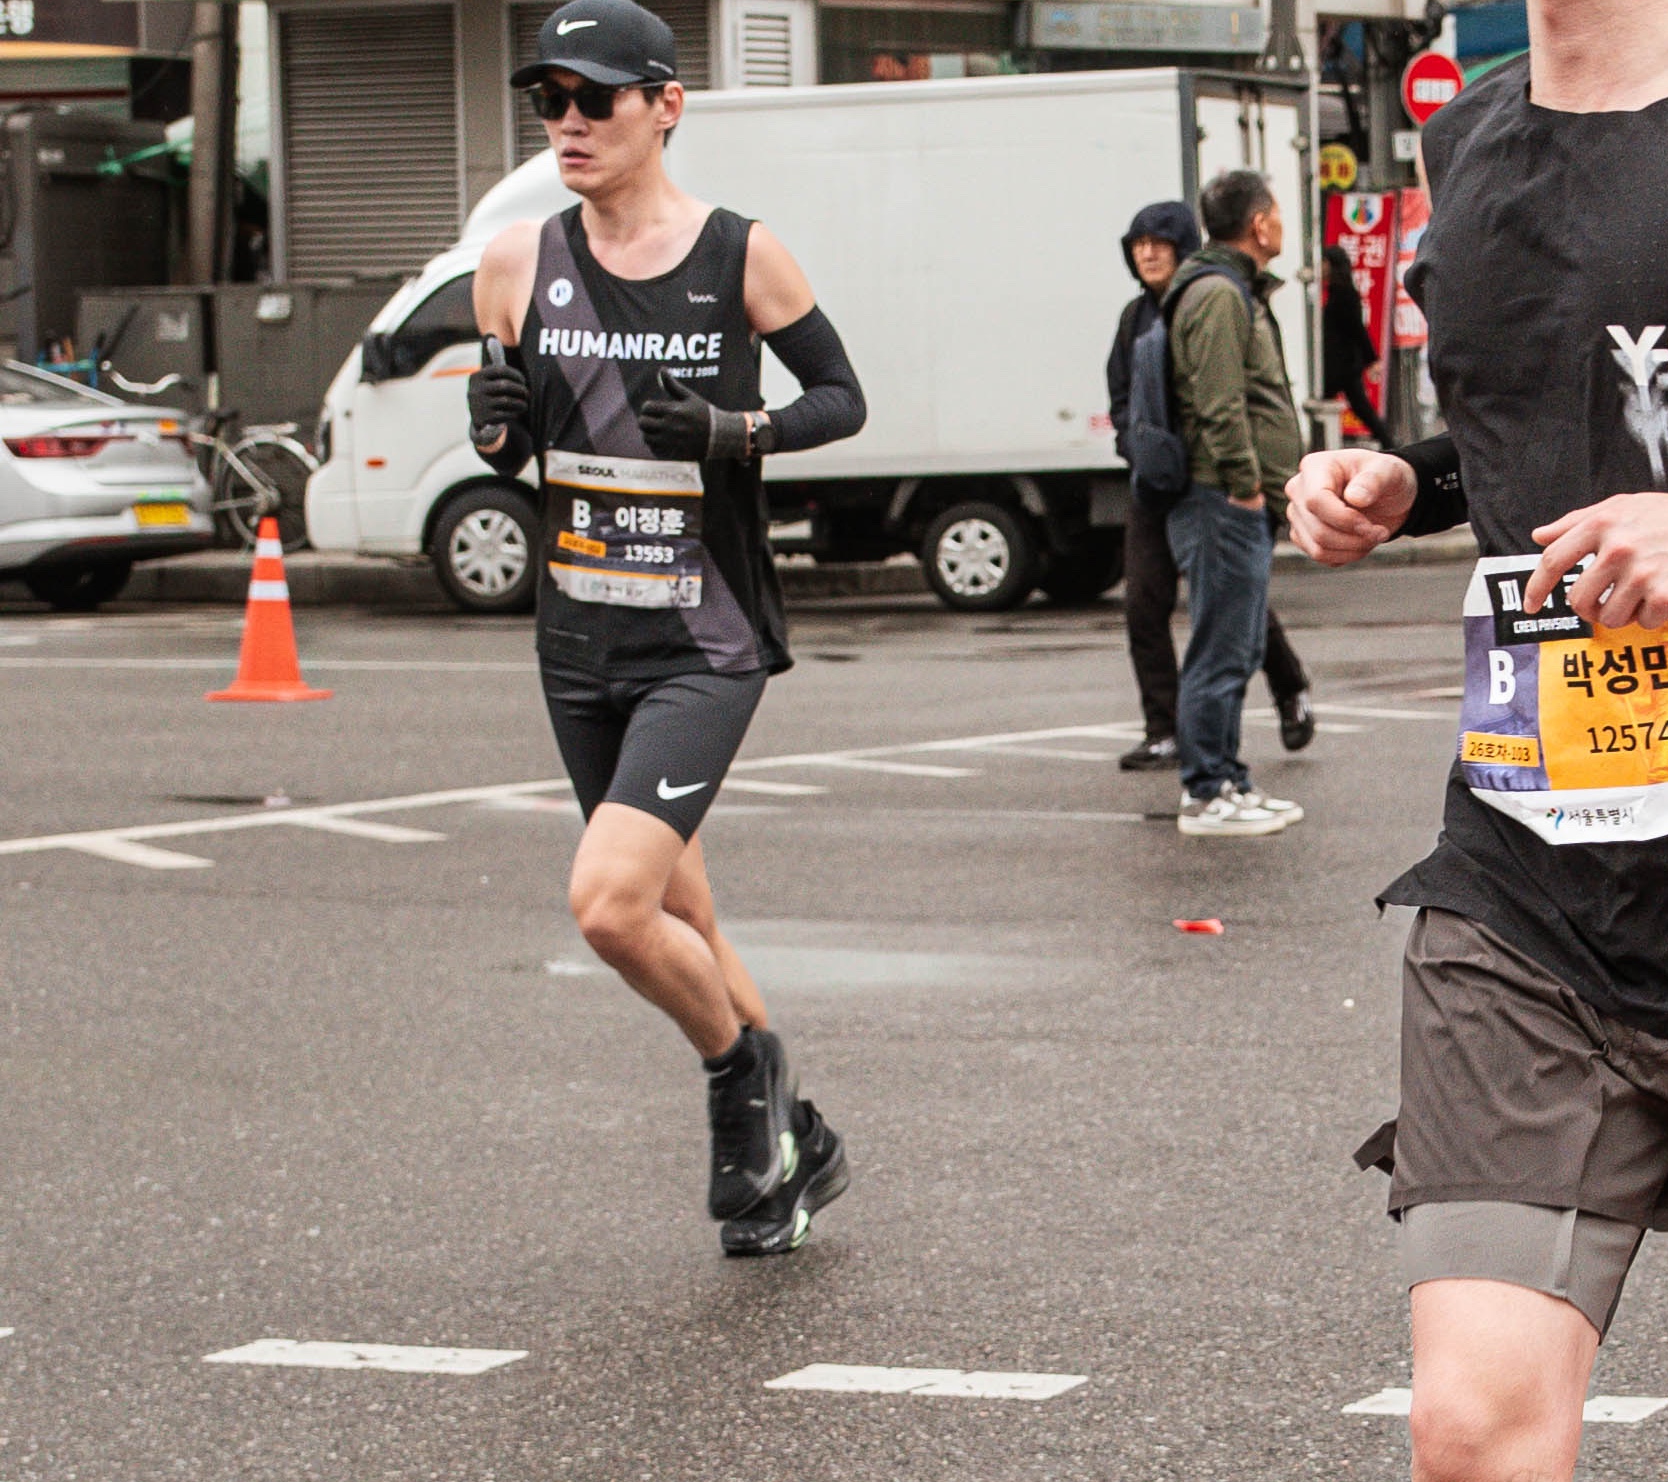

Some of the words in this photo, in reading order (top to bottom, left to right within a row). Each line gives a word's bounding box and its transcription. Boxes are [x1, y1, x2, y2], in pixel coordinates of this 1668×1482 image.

[538, 328, 723, 361] HUMANRACE
[578, 464, 617, 478] SEOUL
[572, 498, 592, 530] B
[614, 505, 686, 536] 이정훈
[623, 544, 675, 564] 13553
[1488, 650, 1517, 705] B
[1568, 806, 1636, 828] 서울특별시
